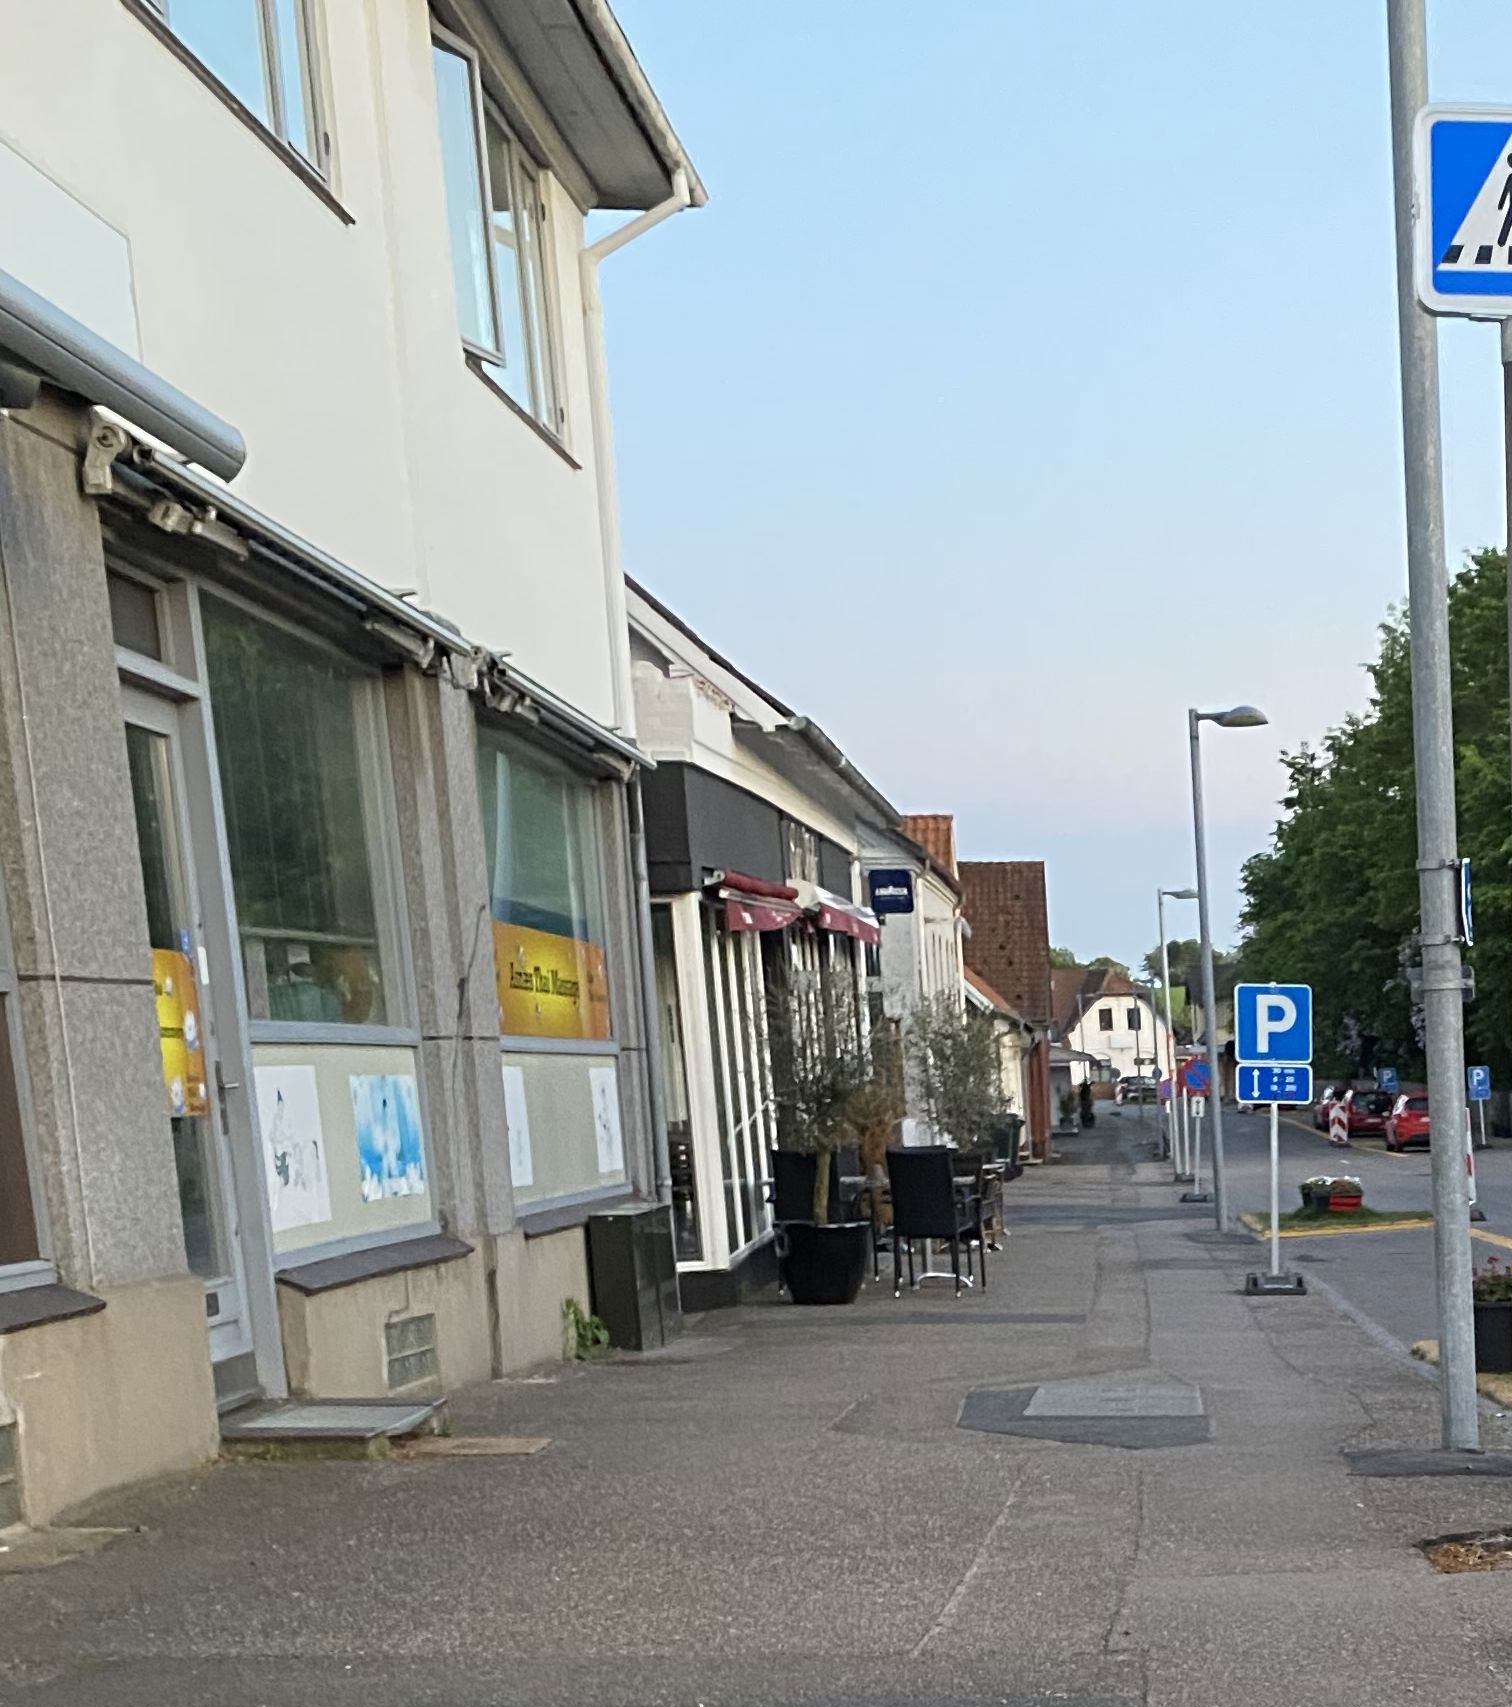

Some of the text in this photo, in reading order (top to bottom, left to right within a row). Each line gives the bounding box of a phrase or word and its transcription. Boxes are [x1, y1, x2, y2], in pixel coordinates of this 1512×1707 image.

[1256, 994, 1297, 1053] P
[1383, 1070, 1392, 1082] P
[1473, 1069, 1484, 1085] P
